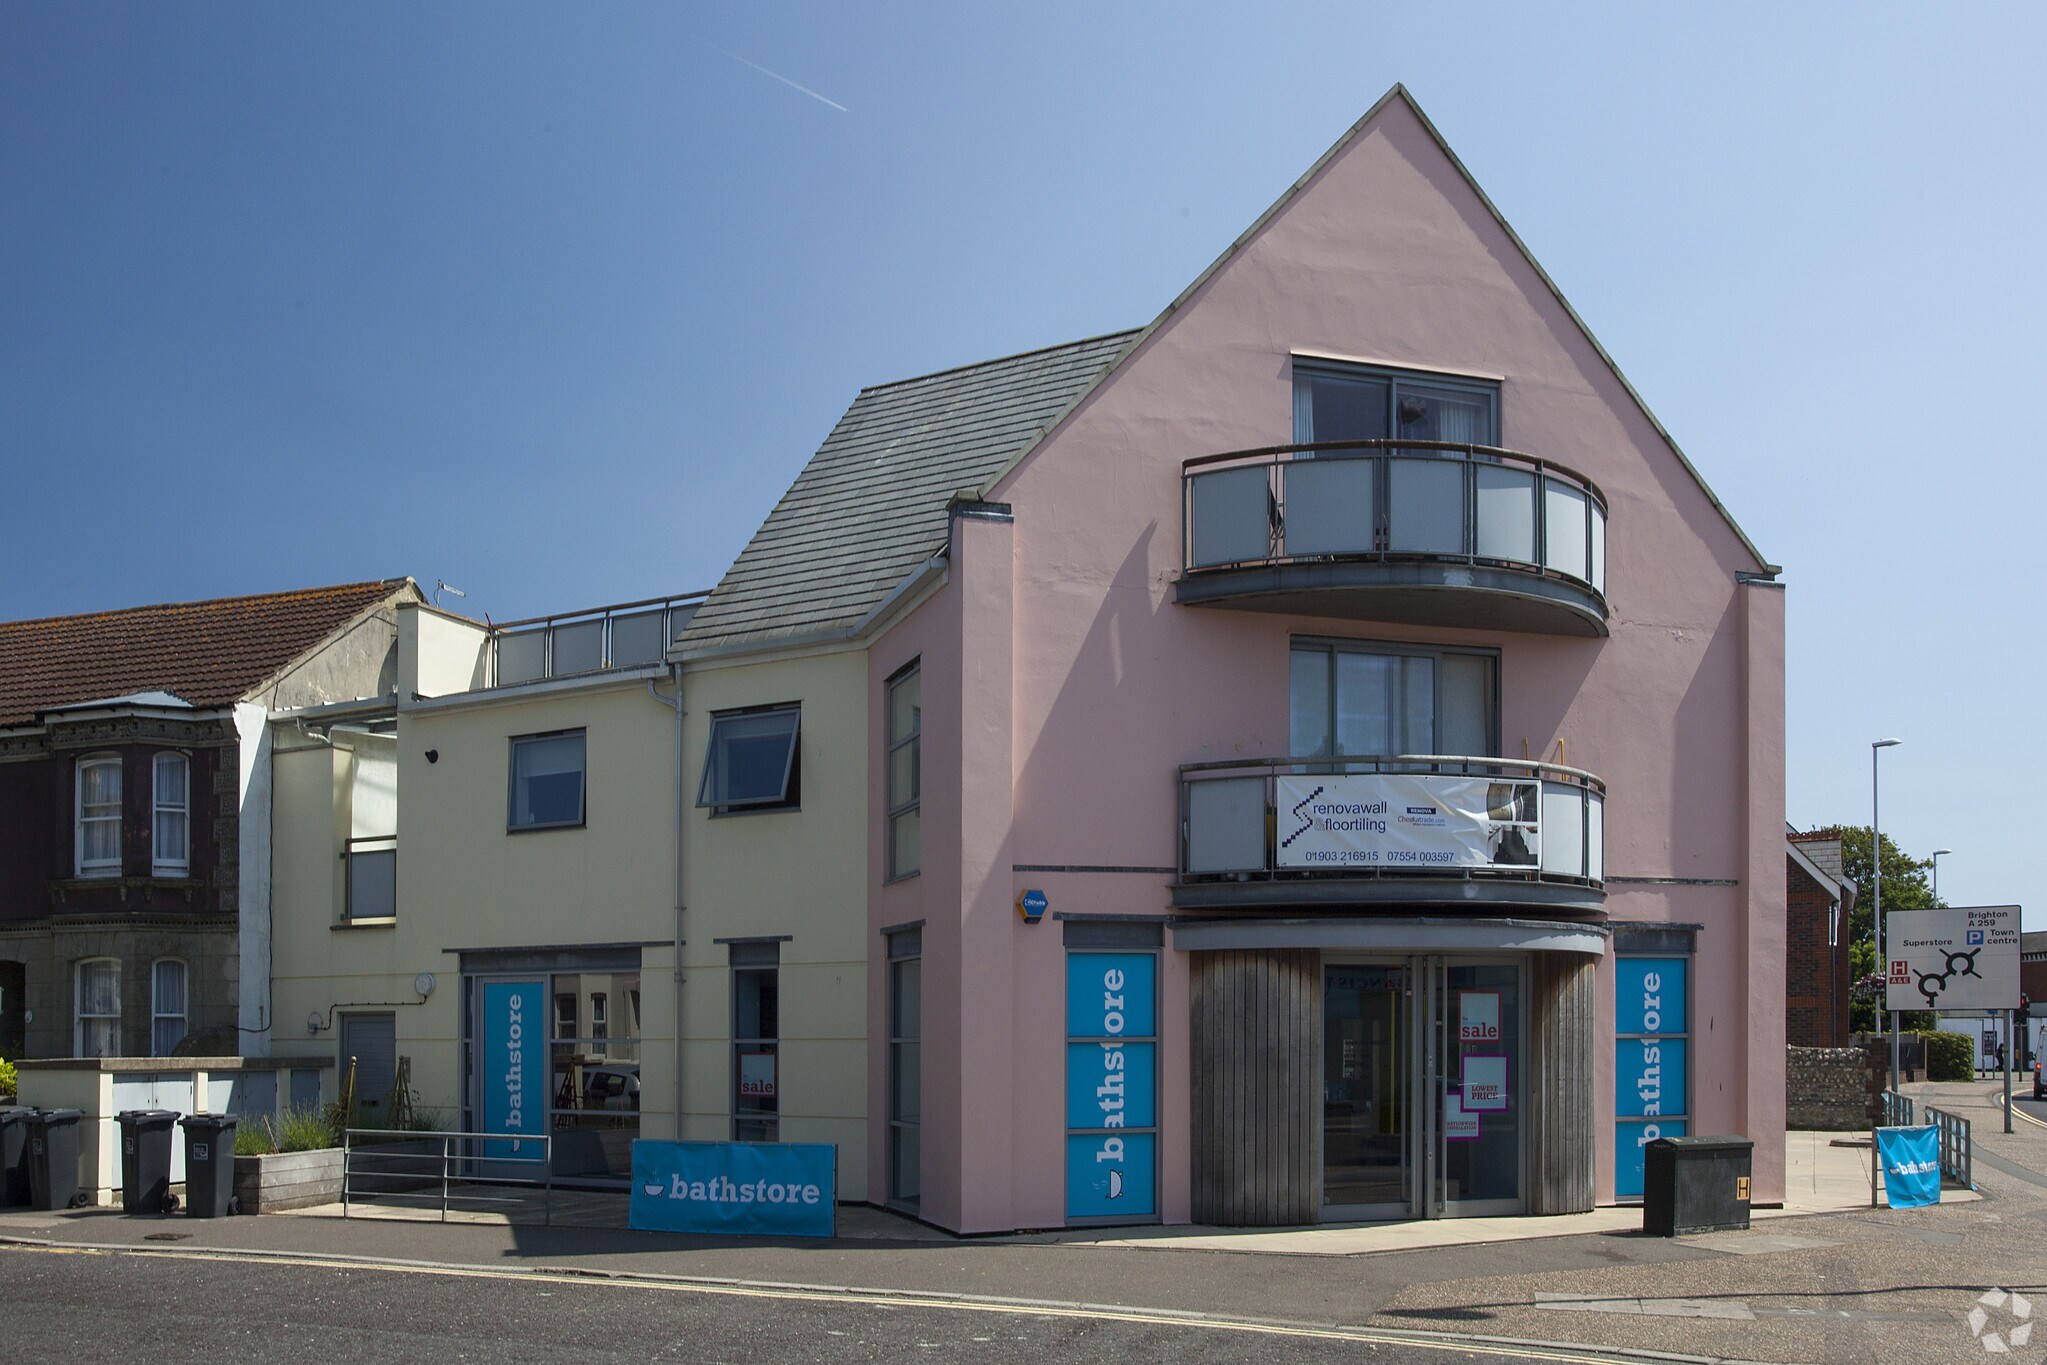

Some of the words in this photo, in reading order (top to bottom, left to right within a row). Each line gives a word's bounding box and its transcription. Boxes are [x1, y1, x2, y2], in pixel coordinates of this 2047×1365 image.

[1313, 801, 1387, 815] renovawall
[1305, 851, 1338, 862] 01903
[1340, 851, 1379, 862] 216915
[1387, 851, 1417, 862] 07554
[1419, 852, 1454, 862] 003597
[1968, 911, 2008, 920] Brighton
[1978, 919, 1996, 927] 259
[1903, 939, 1953, 947] Superstore
[1969, 931, 1981, 942] P
[1987, 937, 2018, 945] centre
[1893, 961, 1906, 975] H
[1462, 1022, 1497, 1038] sale
[505, 994, 522, 1127] bathstore
[1097, 968, 1124, 1163] bathstore
[1638, 972, 1661, 1148] bathstore
[742, 1080, 773, 1093] sale
[668, 1173, 820, 1204] bathstore
[1738, 1178, 1749, 1198] H
